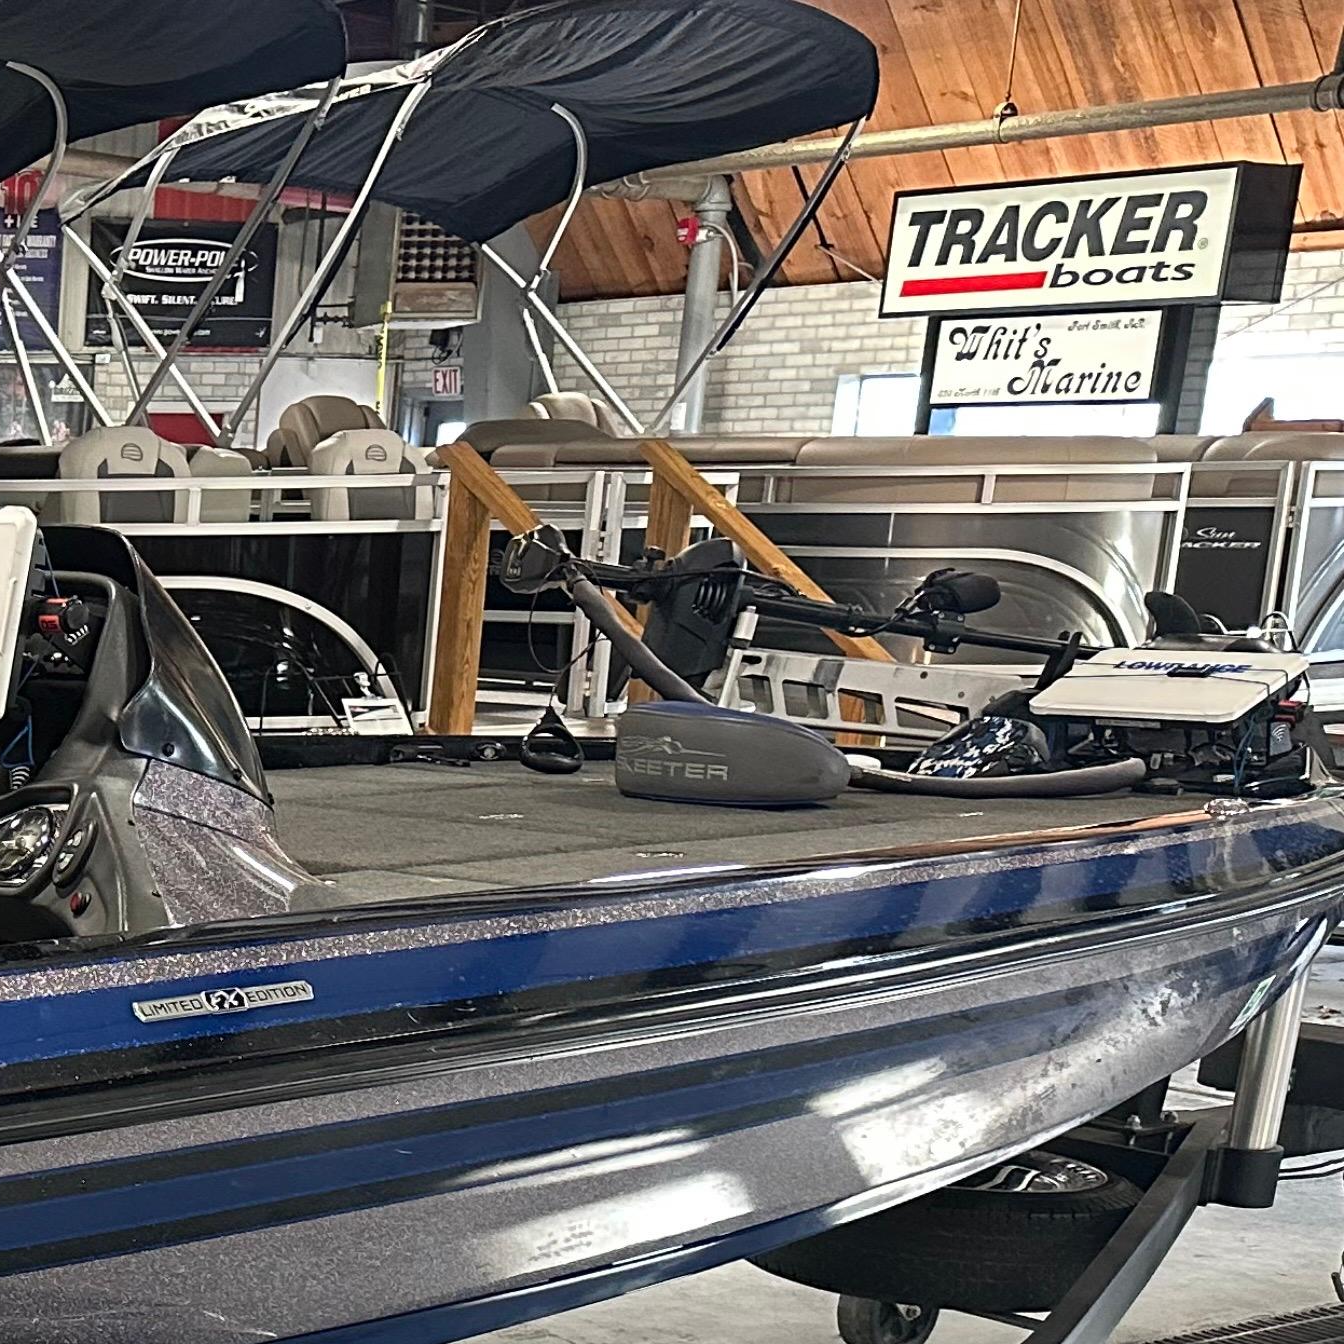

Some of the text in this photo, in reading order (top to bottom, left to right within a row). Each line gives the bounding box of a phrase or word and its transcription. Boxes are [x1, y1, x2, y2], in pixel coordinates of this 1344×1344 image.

[907, 190, 1208, 268] TRACKER
[128, 248, 226, 267] POWER-PO
[1049, 261, 1196, 289] boats
[948, 322, 1052, 362] Whit's
[434, 369, 459, 393] EXIT
[1007, 358, 1142, 396] Marine
[139, 998, 204, 1018] LIMITED
[248, 983, 308, 1004] EDITION
